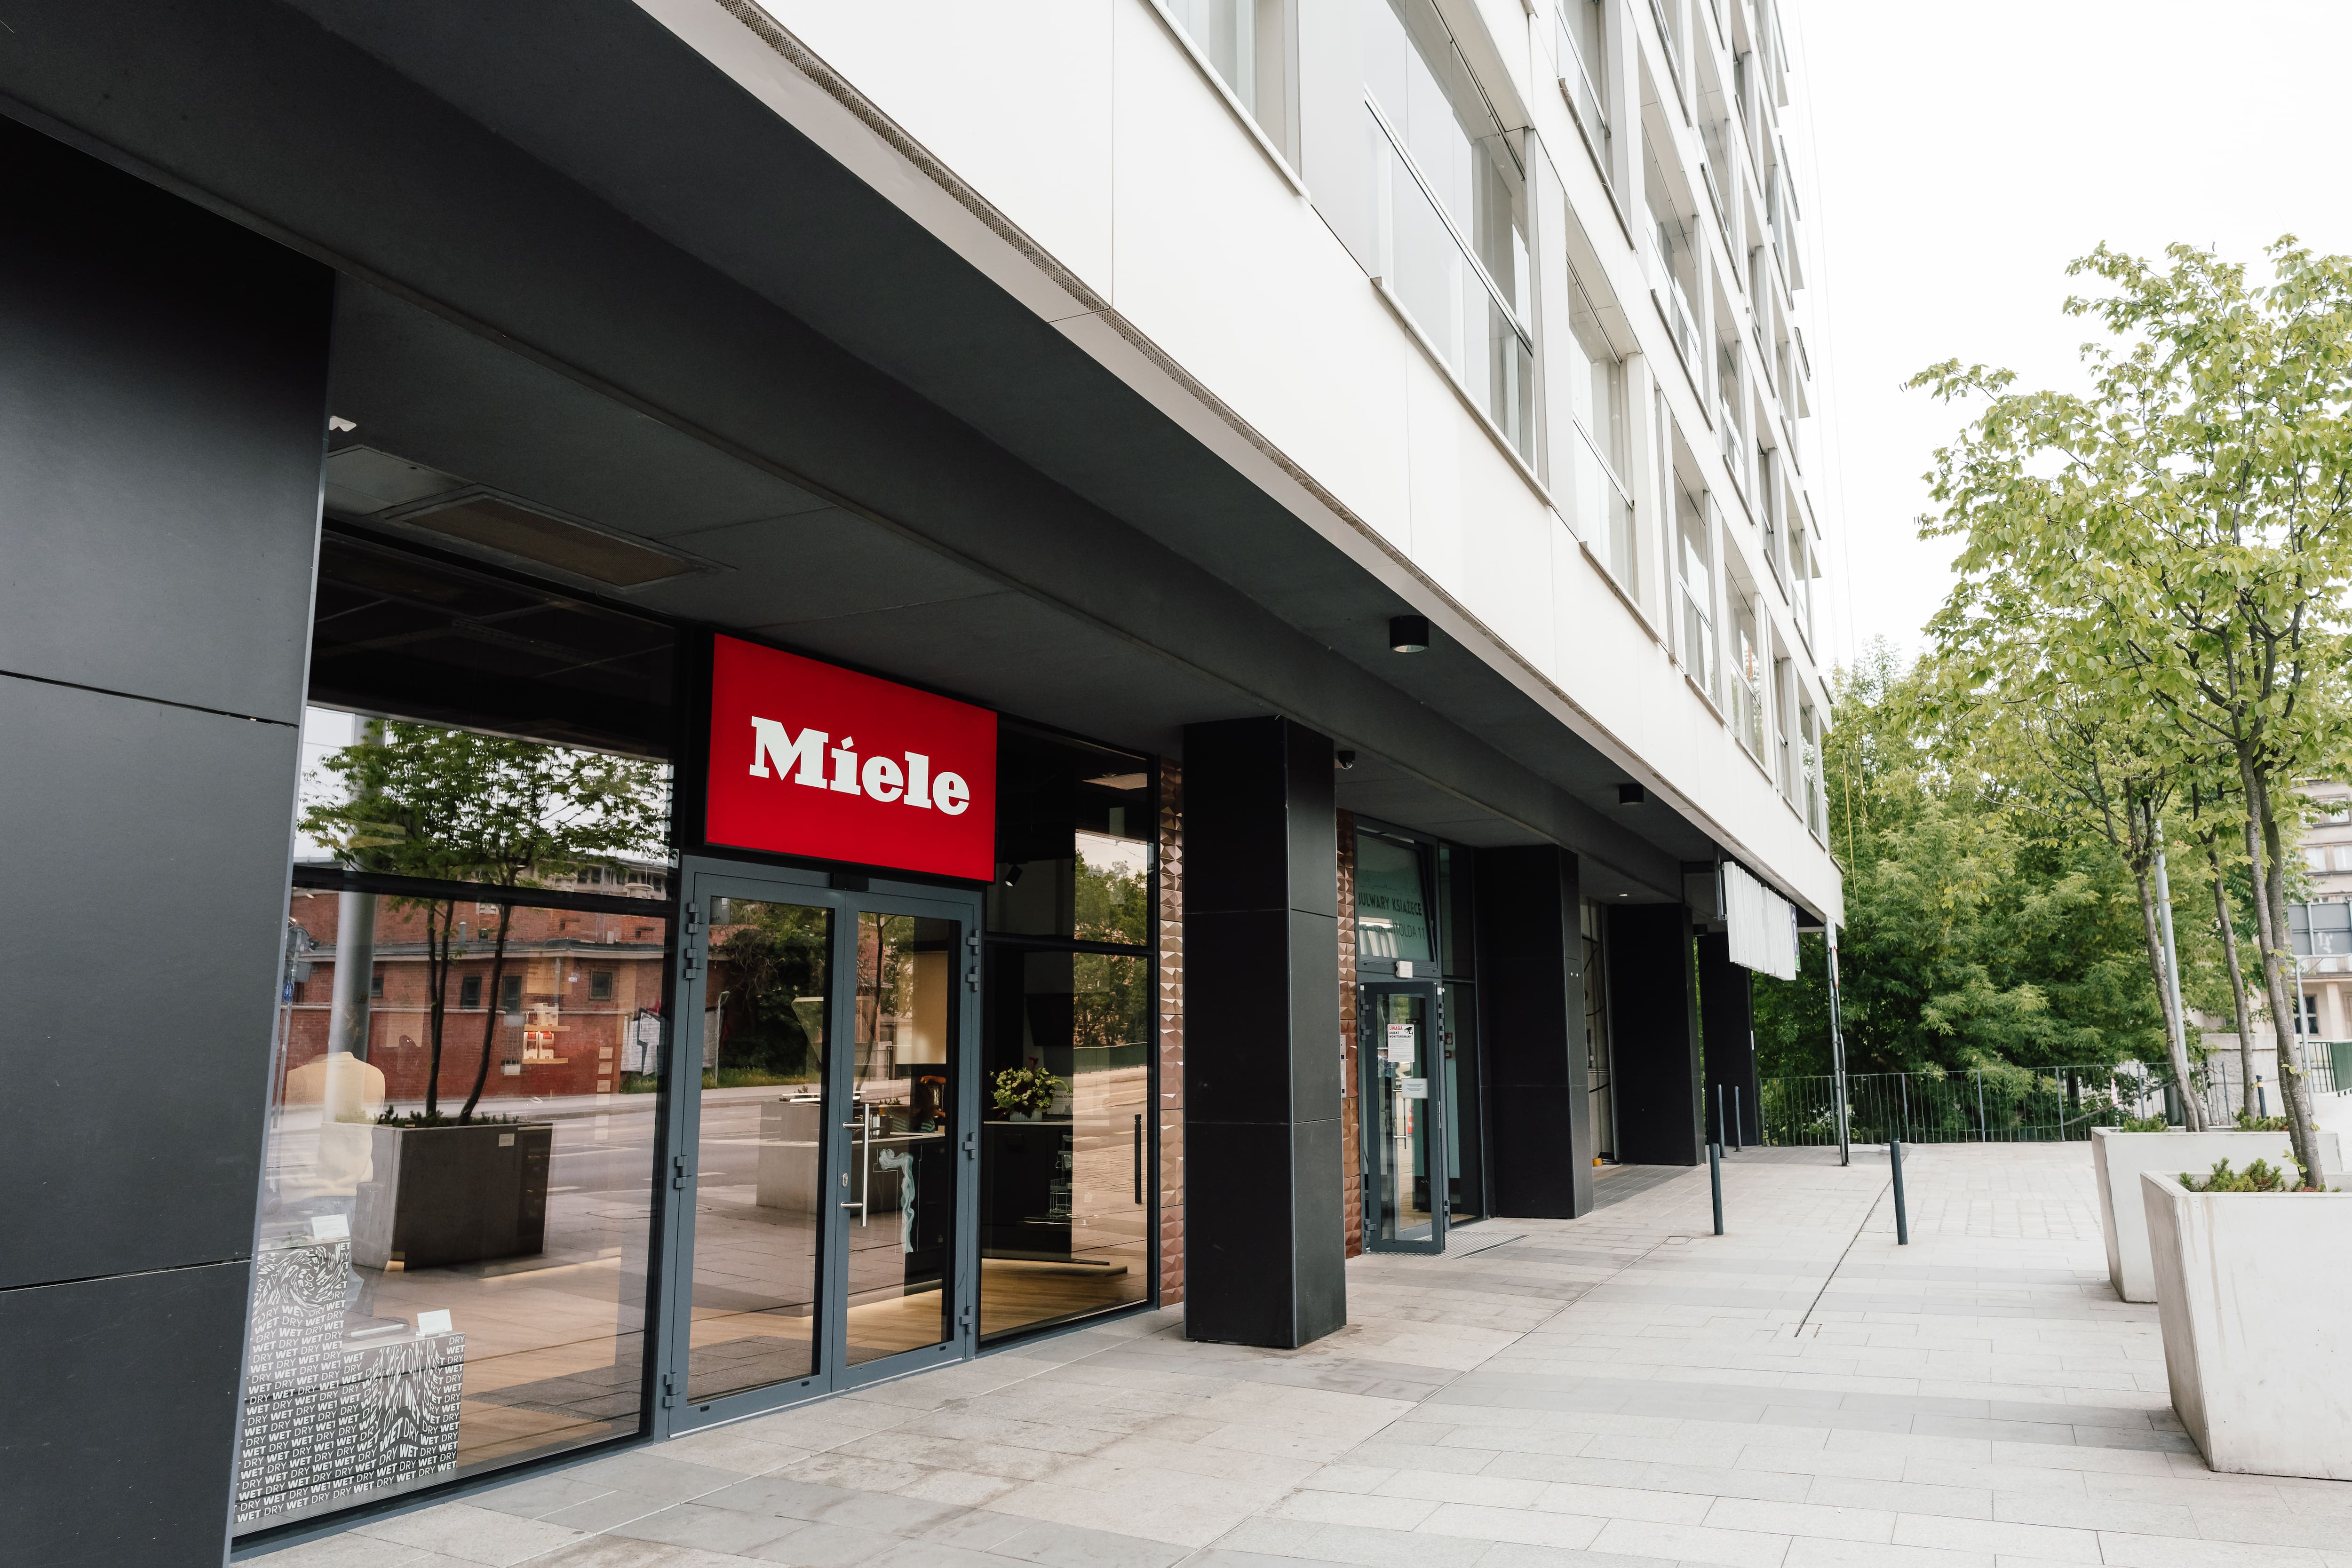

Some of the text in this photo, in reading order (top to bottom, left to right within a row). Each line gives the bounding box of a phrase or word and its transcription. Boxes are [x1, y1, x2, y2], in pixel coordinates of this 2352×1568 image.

[749, 716, 970, 816] Miele
[1418, 927, 1425, 940] 11
[254, 1310, 344, 1335] WET DRY WET DRY
[258, 1306, 279, 1324] DRY
[326, 1300, 346, 1311] WET
[253, 1331, 343, 1353] WET DRY WET DRY
[256, 1320, 344, 1343] DRY WET DRY WET
[250, 1350, 342, 1374] WET DRY WET DRY
[253, 1352, 273, 1363] DRY
[276, 1348, 298, 1359] WET
[301, 1344, 320, 1354] DRY
[344, 1335, 465, 1364] WET DRY
[344, 1344, 465, 1374] DRY WET
[248, 1370, 340, 1395] WET DRY WET DRY
[252, 1372, 272, 1384] DRY
[274, 1368, 297, 1379] WET
[300, 1364, 318, 1375] DRY
[342, 1354, 464, 1385] WET DRY
[342, 1364, 464, 1394] DRY WET
[246, 1390, 339, 1416] WET DRY WET DRY
[250, 1393, 270, 1405] DRY
[272, 1388, 295, 1400] WET
[298, 1384, 317, 1395] DRY
[340, 1393, 361, 1405] WET
[446, 1373, 462, 1383] DRY
[341, 1404, 358, 1415] DRY
[443, 1383, 462, 1394] WET
[245, 1410, 336, 1437] WET DRY WET DRY
[248, 1414, 268, 1426] DRY
[270, 1409, 294, 1421] WET
[296, 1404, 315, 1416] DRY
[338, 1413, 360, 1425] WET
[445, 1393, 461, 1403] DRY
[339, 1425, 357, 1436] DRY
[442, 1402, 461, 1413] WET
[243, 1429, 336, 1458] WET DRY WET DRY
[246, 1435, 266, 1447] DRY
[269, 1430, 292, 1442] WET
[294, 1425, 313, 1436] DRY
[334, 1417, 458, 1467] WET DRY WET DRY WET DRY
[336, 1434, 358, 1447] WET
[443, 1412, 459, 1423] DRY
[337, 1445, 355, 1457] DRY
[357, 1428, 381, 1452] WET
[422, 1419, 438, 1434] DRY
[440, 1421, 460, 1433] WET
[240, 1450, 334, 1480] WET DRY WET DRY
[244, 1456, 264, 1469] DRY
[267, 1450, 290, 1463] WET
[293, 1445, 311, 1457] DRY
[333, 1451, 456, 1489] WET DRY WET DRY WET DRY
[335, 1441, 459, 1478] DRY WET DRY WET DRY WET
[238, 1471, 332, 1501] WET DRY WET DRY
[242, 1478, 262, 1490] DRY
[265, 1471, 288, 1484] WET
[291, 1466, 310, 1478] DRY
[333, 1460, 457, 1499] DRY WET DRY WET DRY WET
[237, 1492, 330, 1522] WET DRY WET DRY
[240, 1498, 261, 1512] DRY
[263, 1492, 287, 1505] WET
[289, 1487, 309, 1499] DRY
